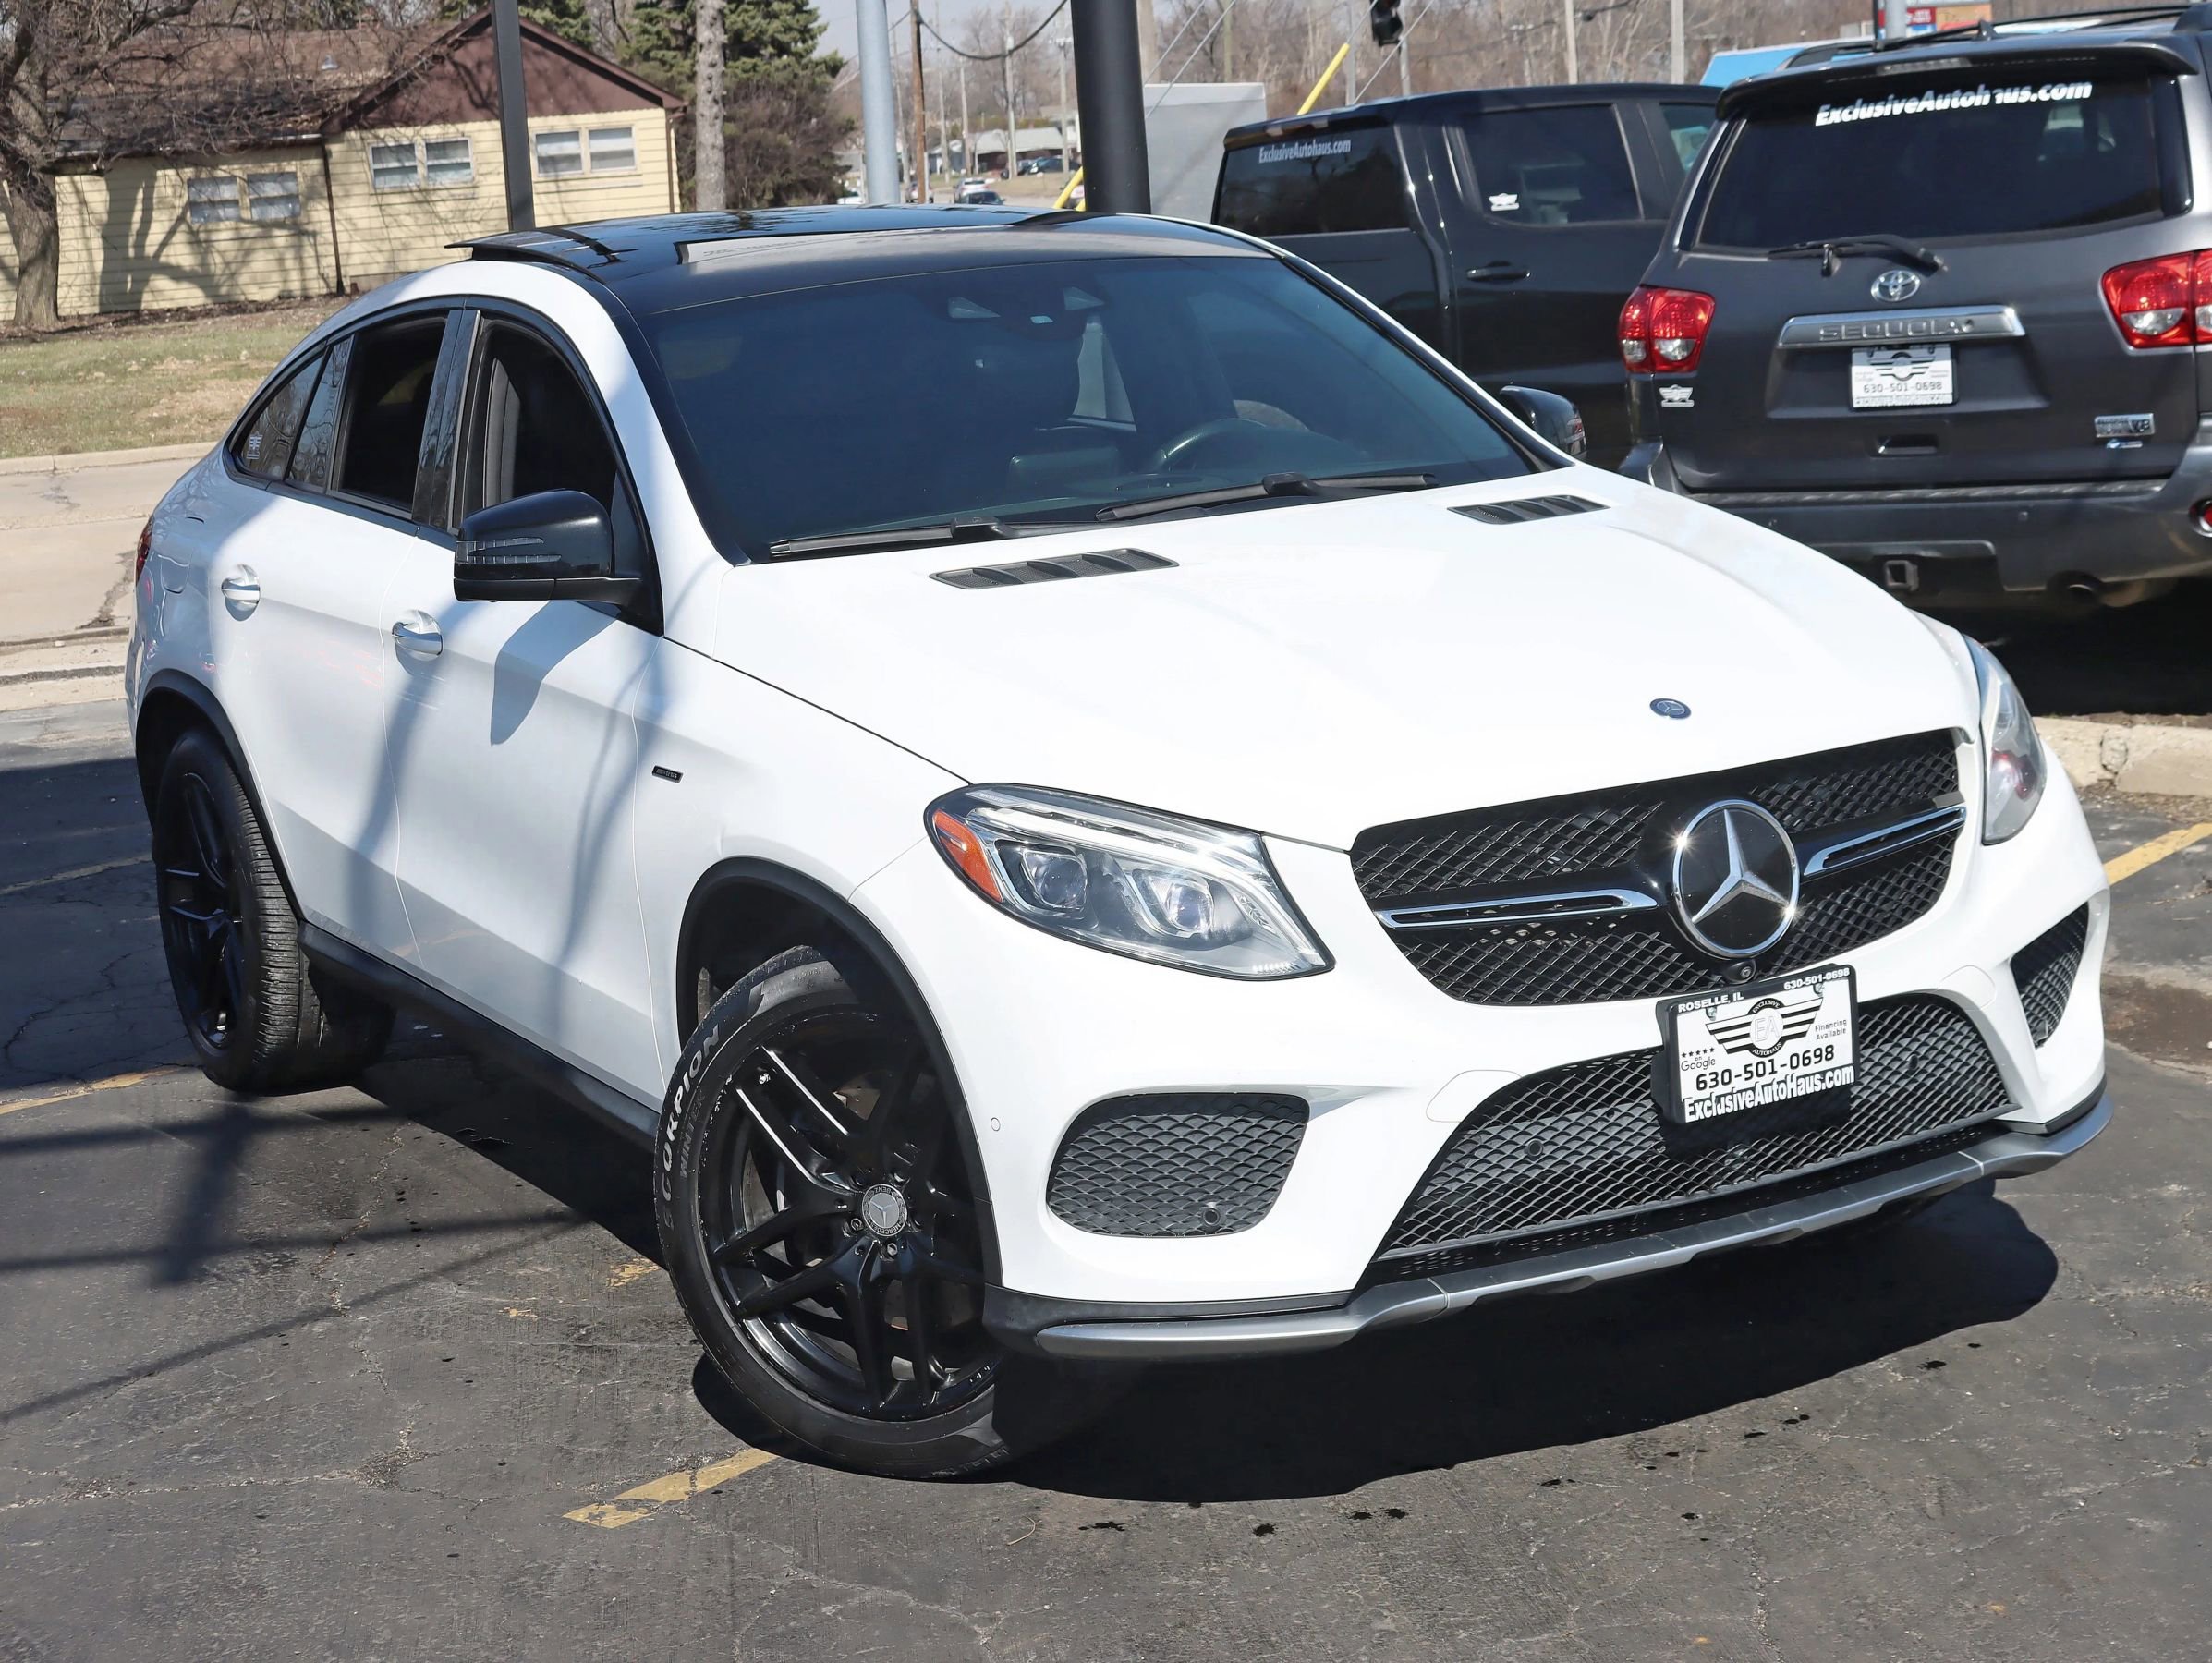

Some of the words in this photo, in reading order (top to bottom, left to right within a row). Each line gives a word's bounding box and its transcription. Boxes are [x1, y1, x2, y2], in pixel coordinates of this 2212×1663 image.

[1258, 139, 1351, 164] ExclusiveAutohaus.com
[1863, 382, 1943, 394] 630-501-0698
[1783, 967, 1851, 990] 630-501-0698
[1678, 995, 1731, 1014] ROSELLE,
[1732, 991, 1744, 1002] IL
[1752, 999, 1781, 1014] EXCLUSIVE
[1755, 1015, 1780, 1042] EA
[1815, 1019, 1847, 1032] Financing
[1816, 1027, 1846, 1040] Available
[1752, 1041, 1782, 1056] AUTOHAUS
[1681, 1056, 1716, 1071] Google
[1695, 1044, 1835, 1091] 630-501-0698
[1684, 1064, 1855, 1123] ExclusiveAutoHaus.com
